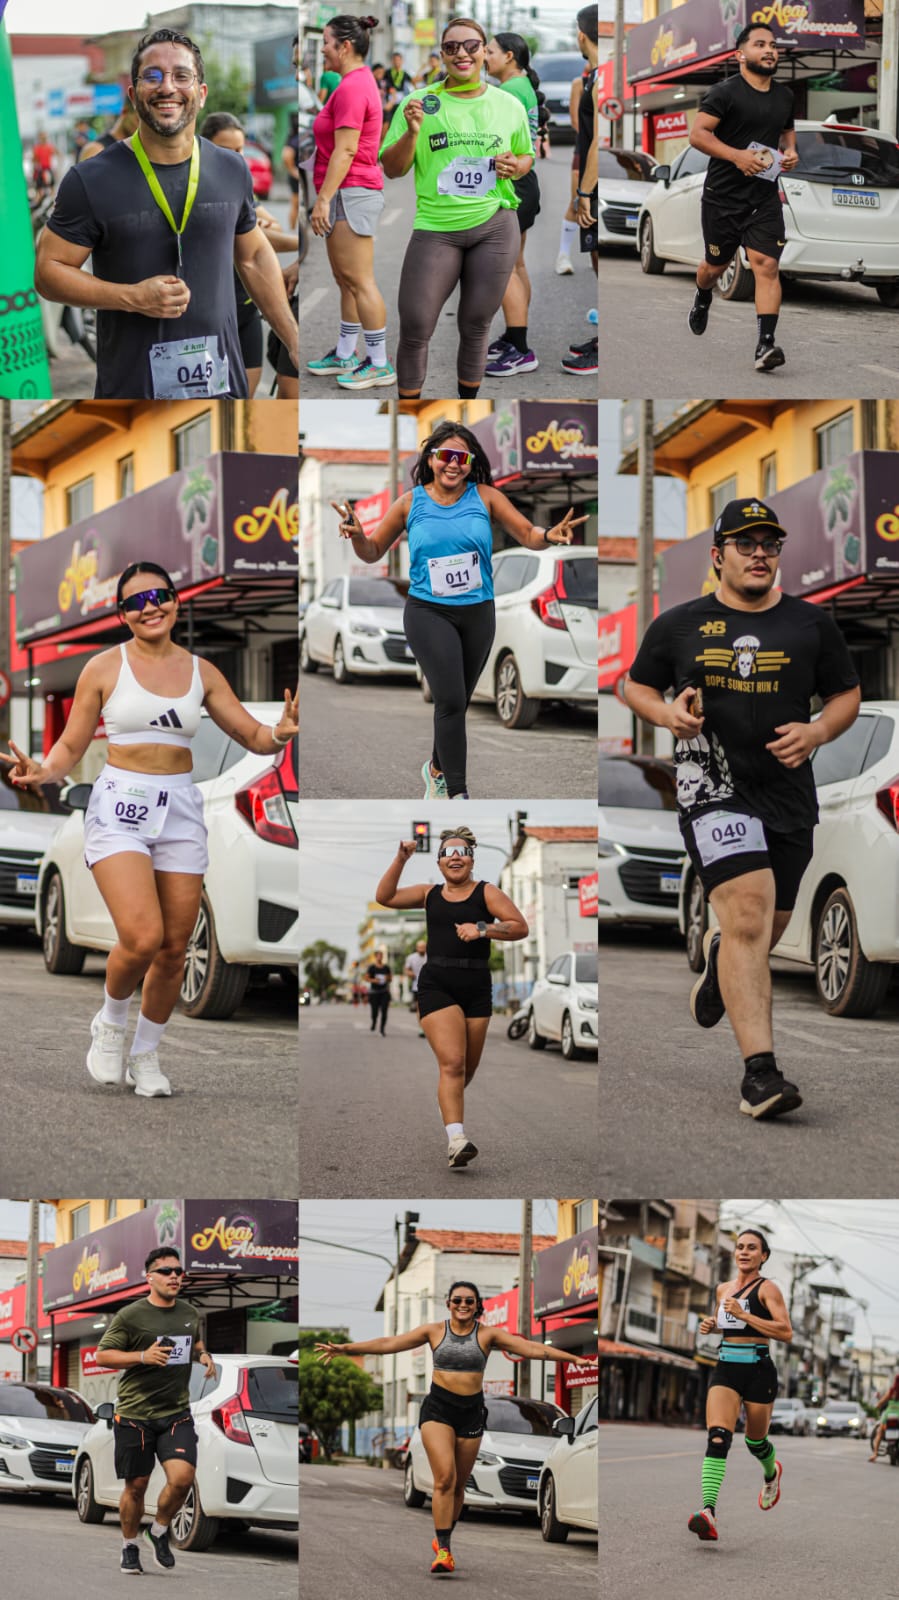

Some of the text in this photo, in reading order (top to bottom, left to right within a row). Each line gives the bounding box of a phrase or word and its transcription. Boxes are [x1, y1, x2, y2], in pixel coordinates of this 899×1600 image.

[454, 171, 483, 185] 019
[177, 361, 213, 384] 045
[445, 569, 470, 585] 011
[727, 678, 755, 692] SUNSET
[756, 681, 772, 693] RUN
[772, 681, 779, 692] 4
[115, 801, 149, 821] 082
[711, 822, 747, 842] 040
